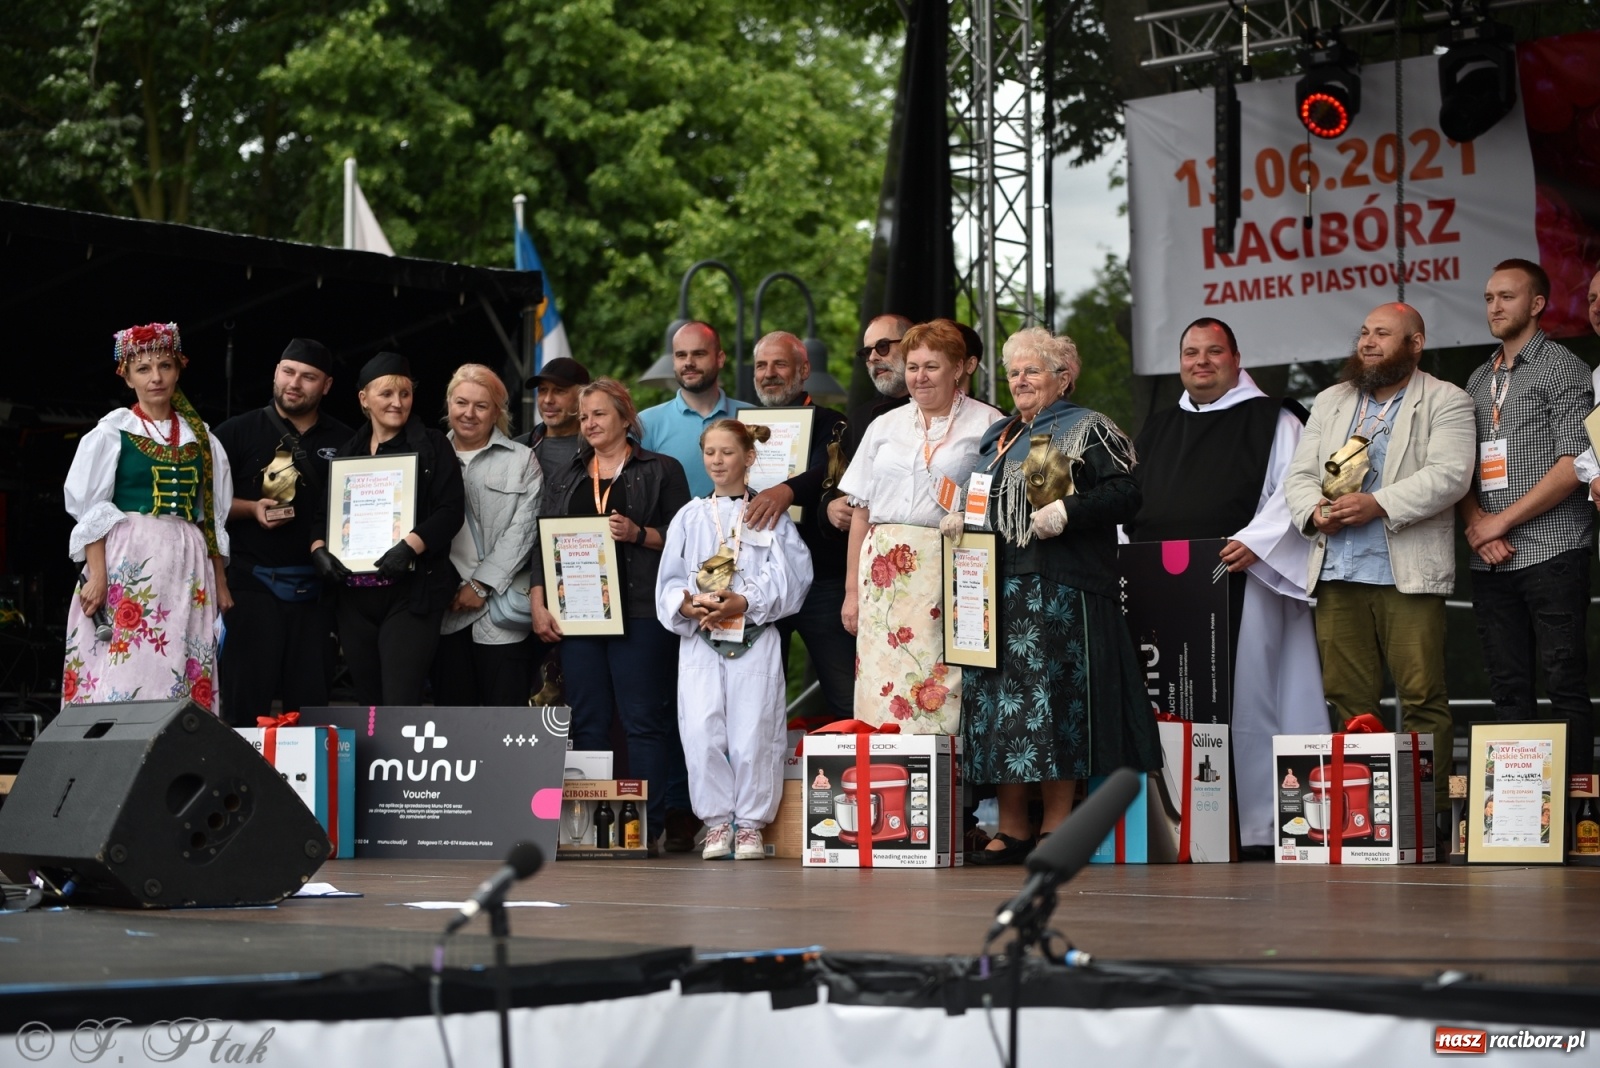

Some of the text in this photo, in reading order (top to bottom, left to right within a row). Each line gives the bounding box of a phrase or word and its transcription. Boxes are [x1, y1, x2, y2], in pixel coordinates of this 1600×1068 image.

[1174, 128, 1477, 209] 1.06.2021
[1203, 257, 1460, 306] ZAMEK PIASTOWSKI
[1192, 733, 1223, 748] Qilive
[1511, 746, 1537, 754] Festiwal
[1491, 752, 1544, 762] Śląskie Smaki
[368, 758, 477, 782] munu
[402, 790, 441, 799] Voucher
[873, 853, 901, 862] Kneading
